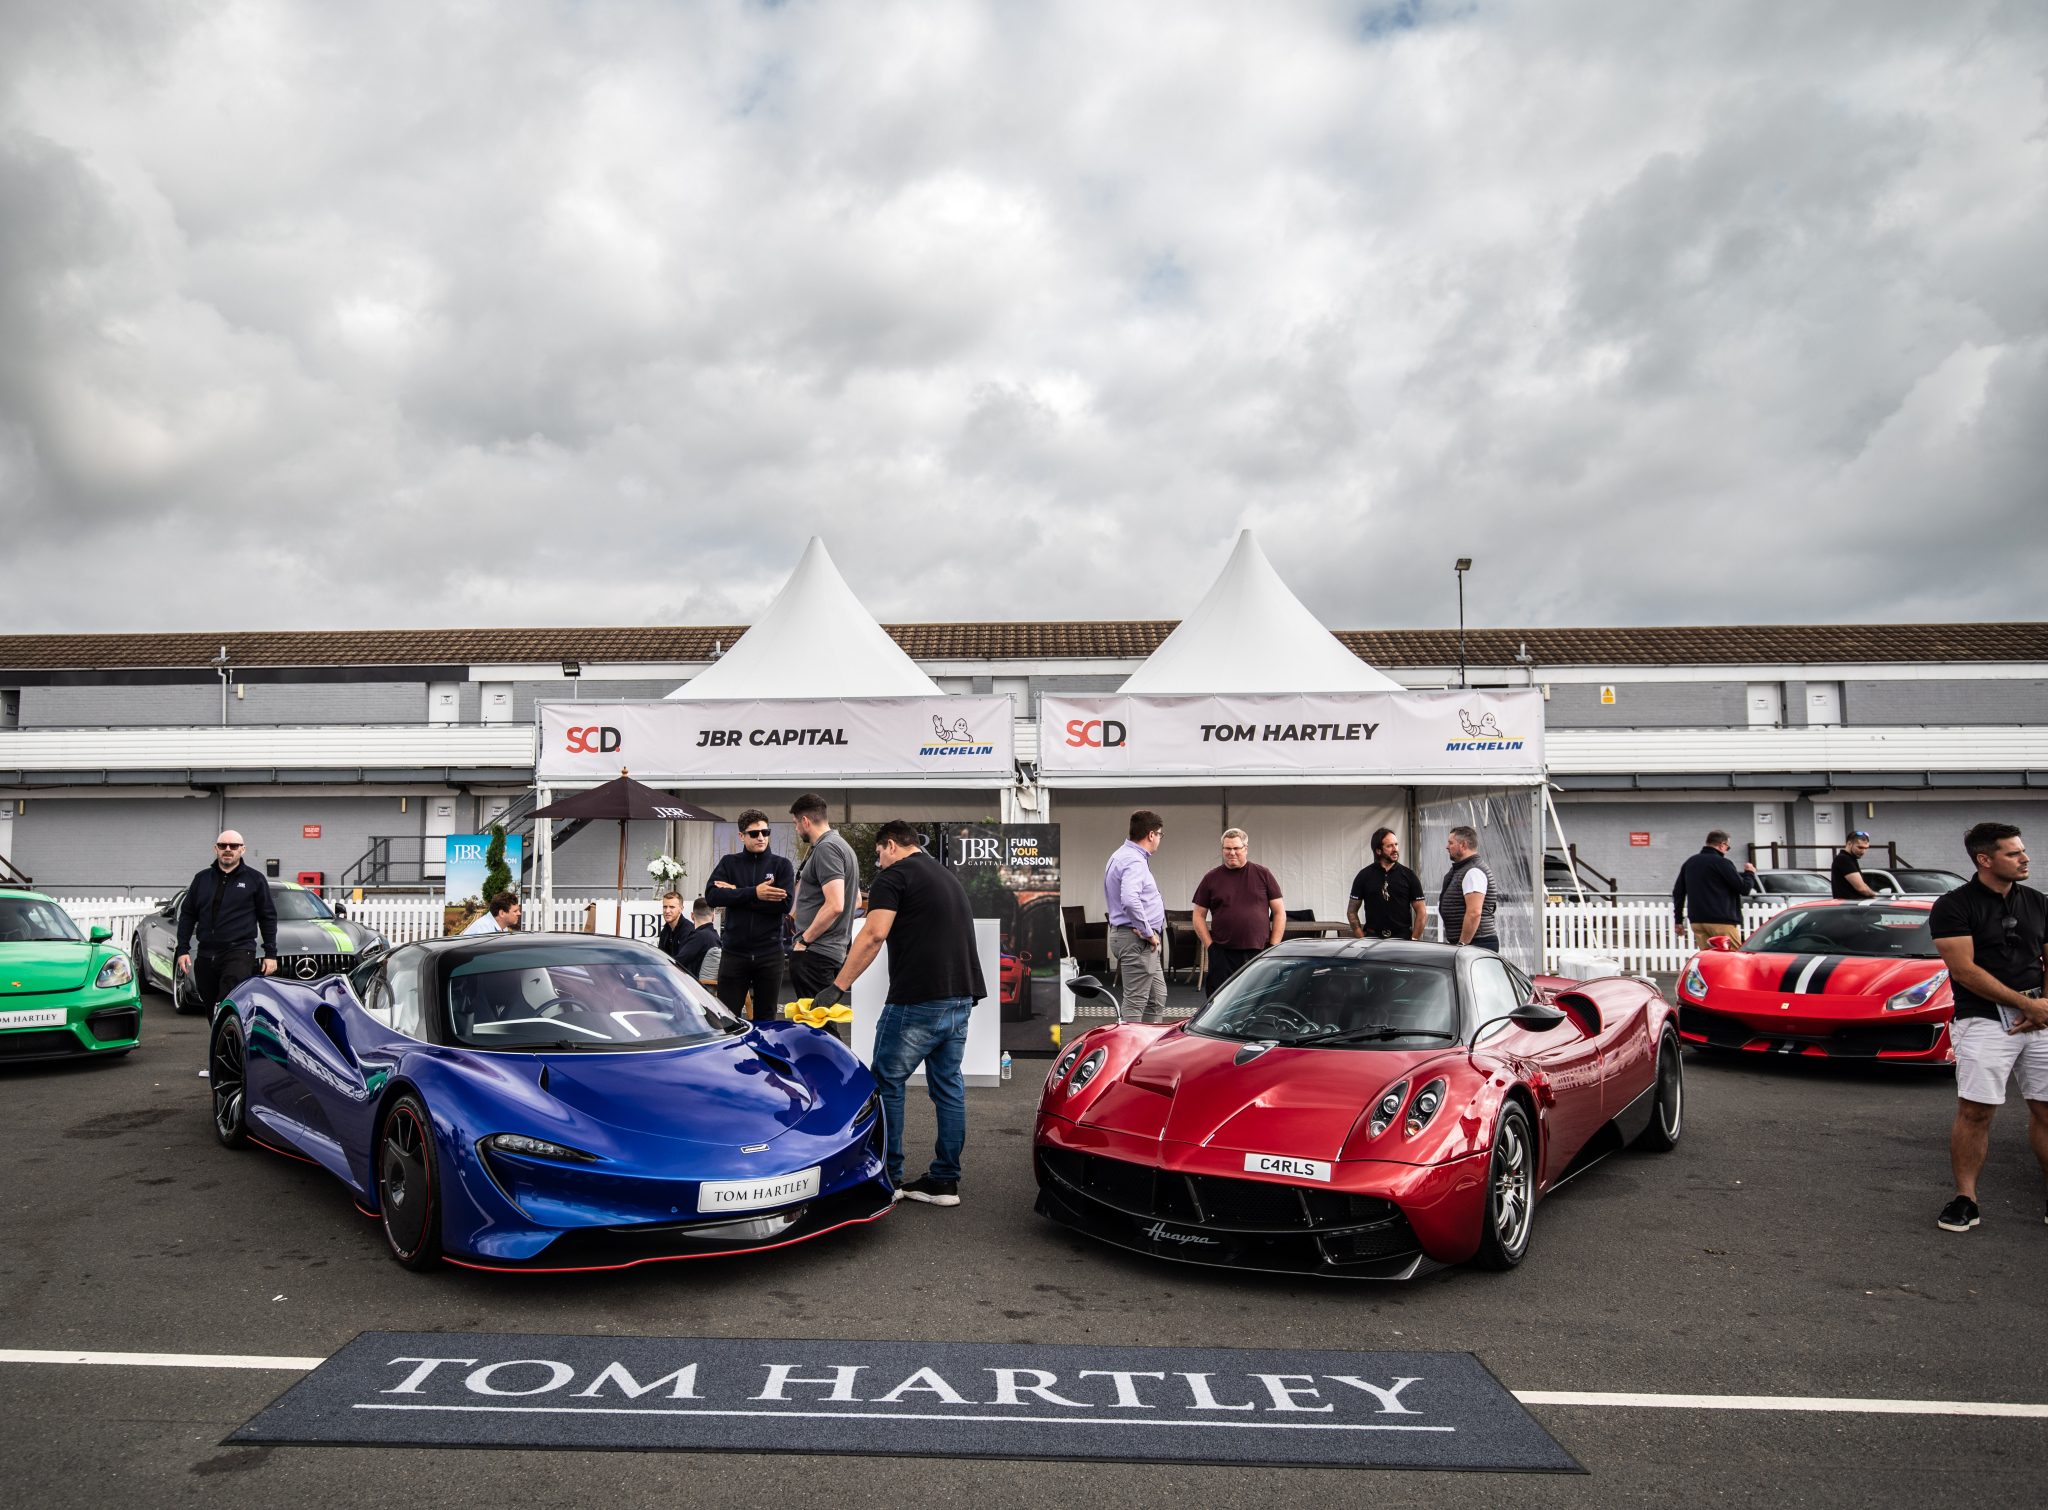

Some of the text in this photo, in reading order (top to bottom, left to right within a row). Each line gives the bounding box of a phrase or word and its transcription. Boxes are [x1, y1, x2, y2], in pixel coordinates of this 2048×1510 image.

[696, 729, 848, 747] JBR CAPITAL
[1200, 723, 1379, 742] TOM HARTLEY
[919, 745, 993, 756] MICHELIN
[1446, 741, 1524, 751] MICHELIN
[651, 806, 693, 819] JBR
[1010, 838, 1038, 847] FUND
[1010, 847, 1038, 856] YOUR
[450, 844, 484, 864] JBR
[953, 838, 1003, 866] JBR
[1010, 856, 1053, 866] PASSION
[13, 1013, 57, 1023] HARTLEY
[1260, 1158, 1315, 1176] C4RLS
[714, 1178, 809, 1202] TOM HARTLEY
[1143, 1222, 1220, 1245] Huayra
[379, 1357, 1424, 1415] TOM HARTLEY
